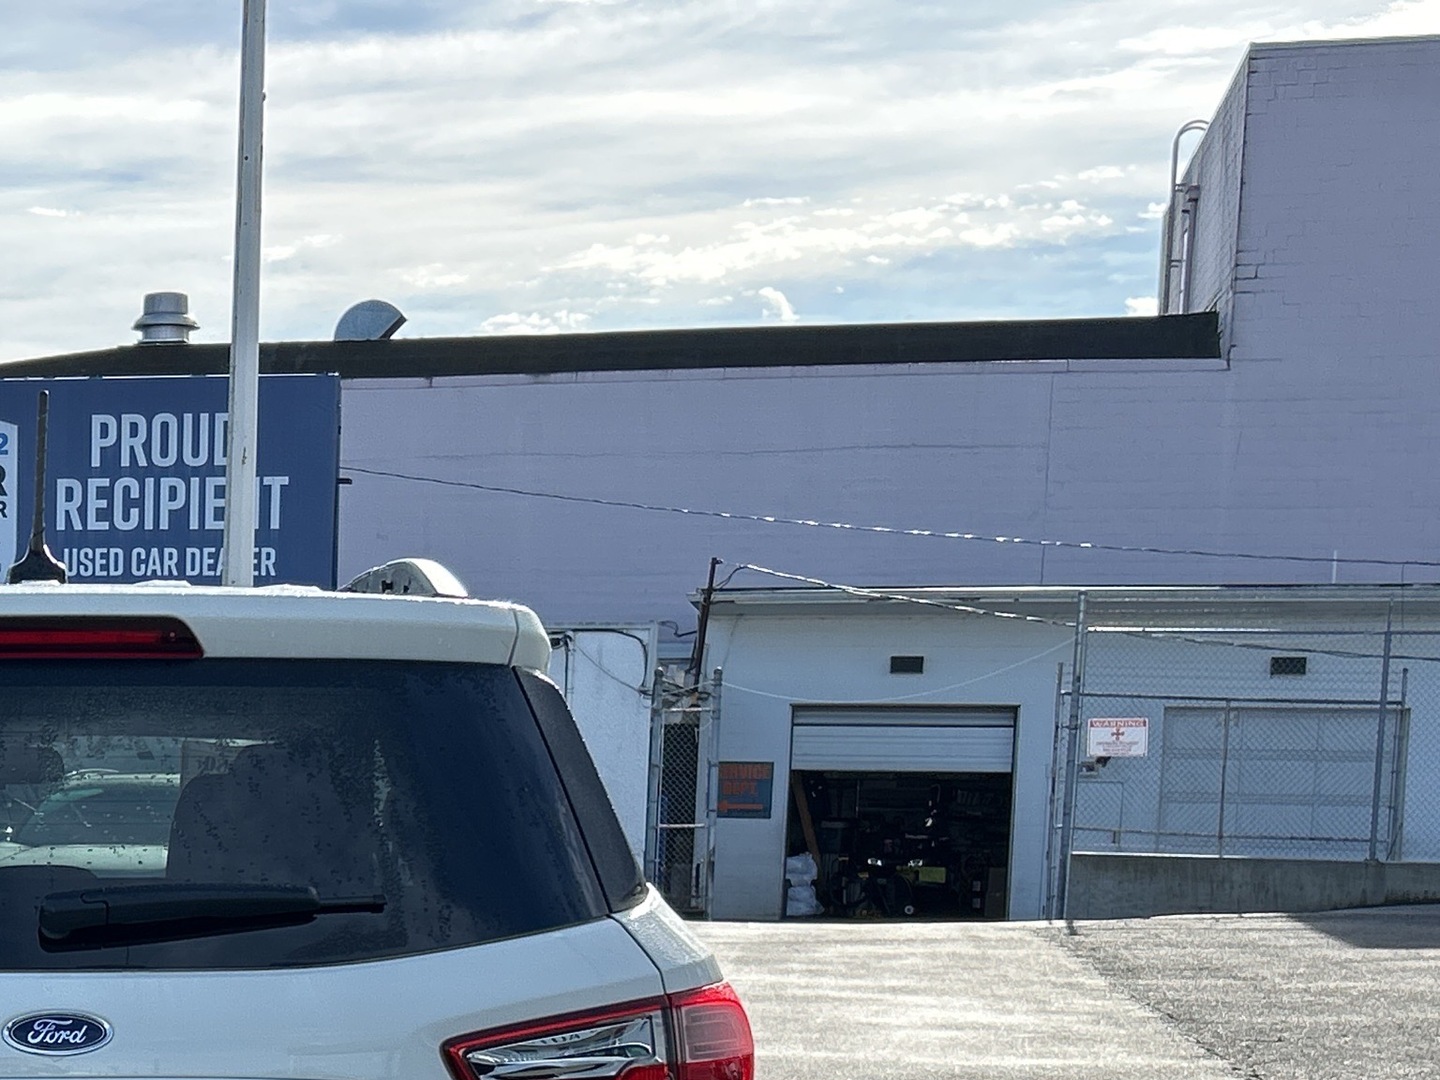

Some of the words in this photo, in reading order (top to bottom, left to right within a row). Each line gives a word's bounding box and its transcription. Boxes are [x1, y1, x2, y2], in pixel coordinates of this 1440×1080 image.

[90, 412, 228, 468] PROUD
[56, 475, 290, 531] RECIPIET
[63, 547, 124, 577] USED
[131, 547, 179, 577] CAR
[185, 547, 276, 577] DEAER
[1092, 719, 1145, 728] WARNING
[27, 1019, 88, 1044] Ford
